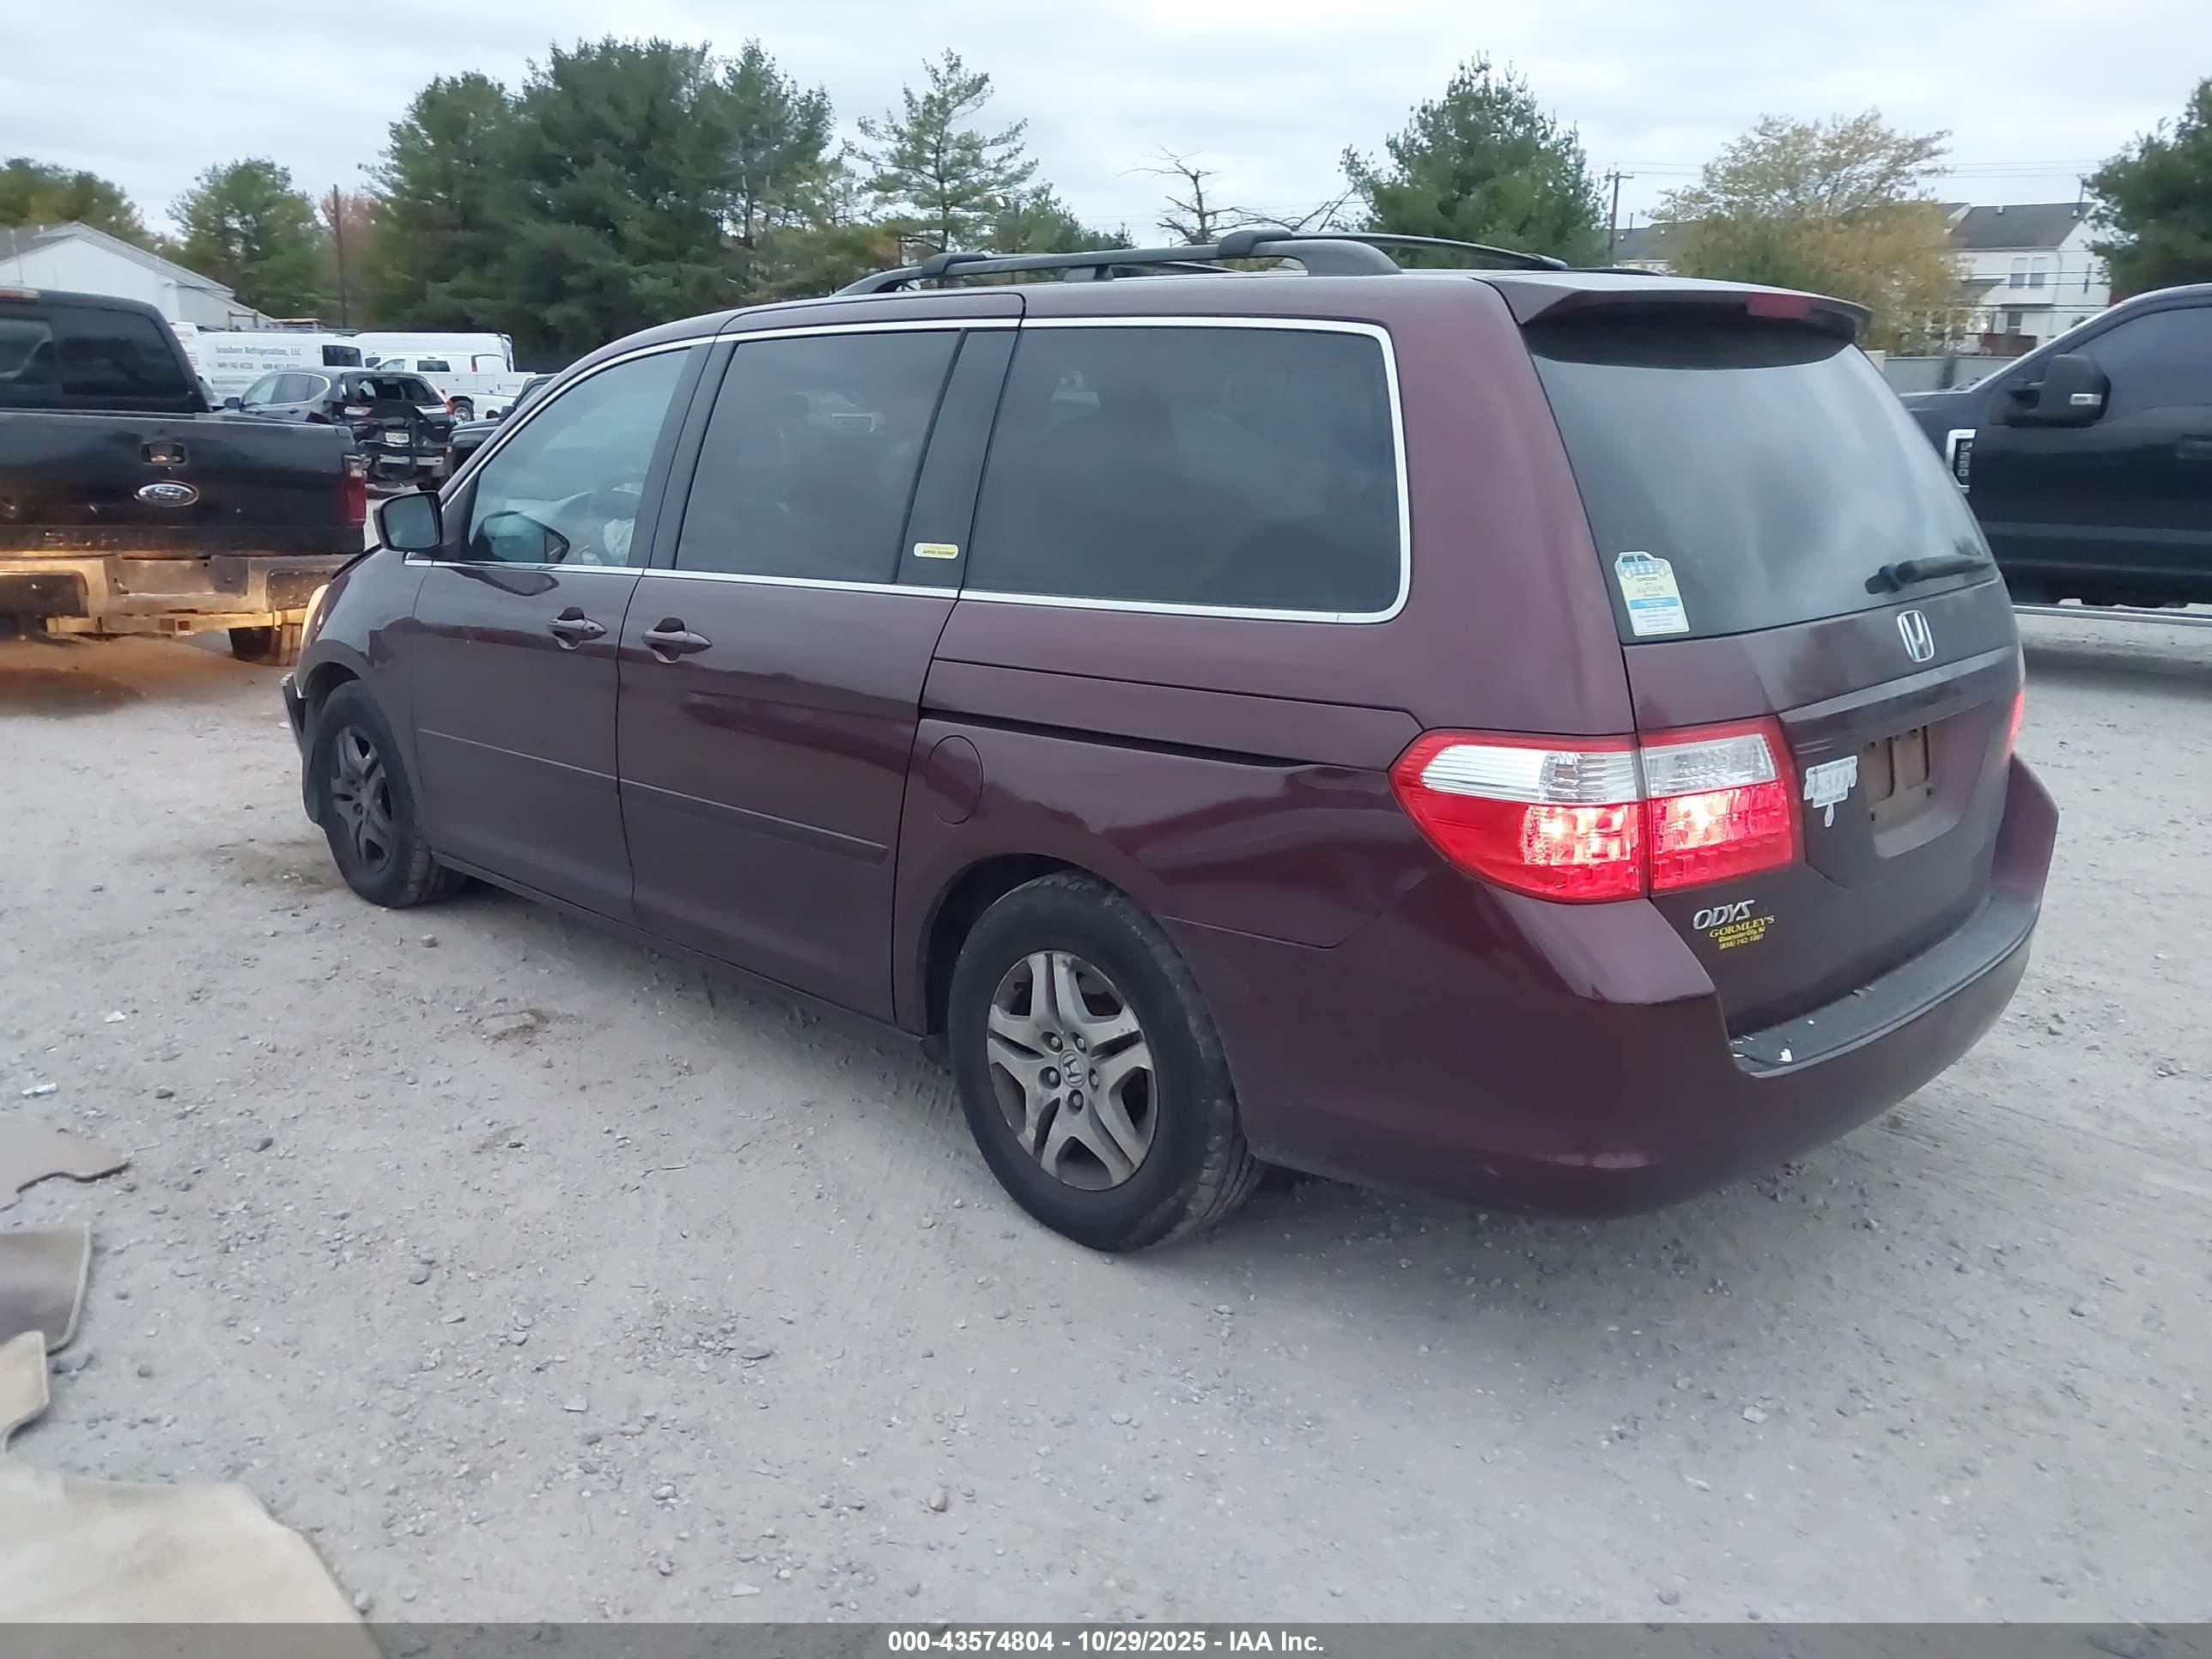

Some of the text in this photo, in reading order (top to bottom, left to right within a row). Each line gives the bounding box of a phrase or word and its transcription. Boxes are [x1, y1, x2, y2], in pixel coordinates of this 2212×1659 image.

[290, 347, 302, 356] LLC
[1692, 899, 1756, 930] ODYS
[1710, 915, 1775, 939] GORMLEY'S
